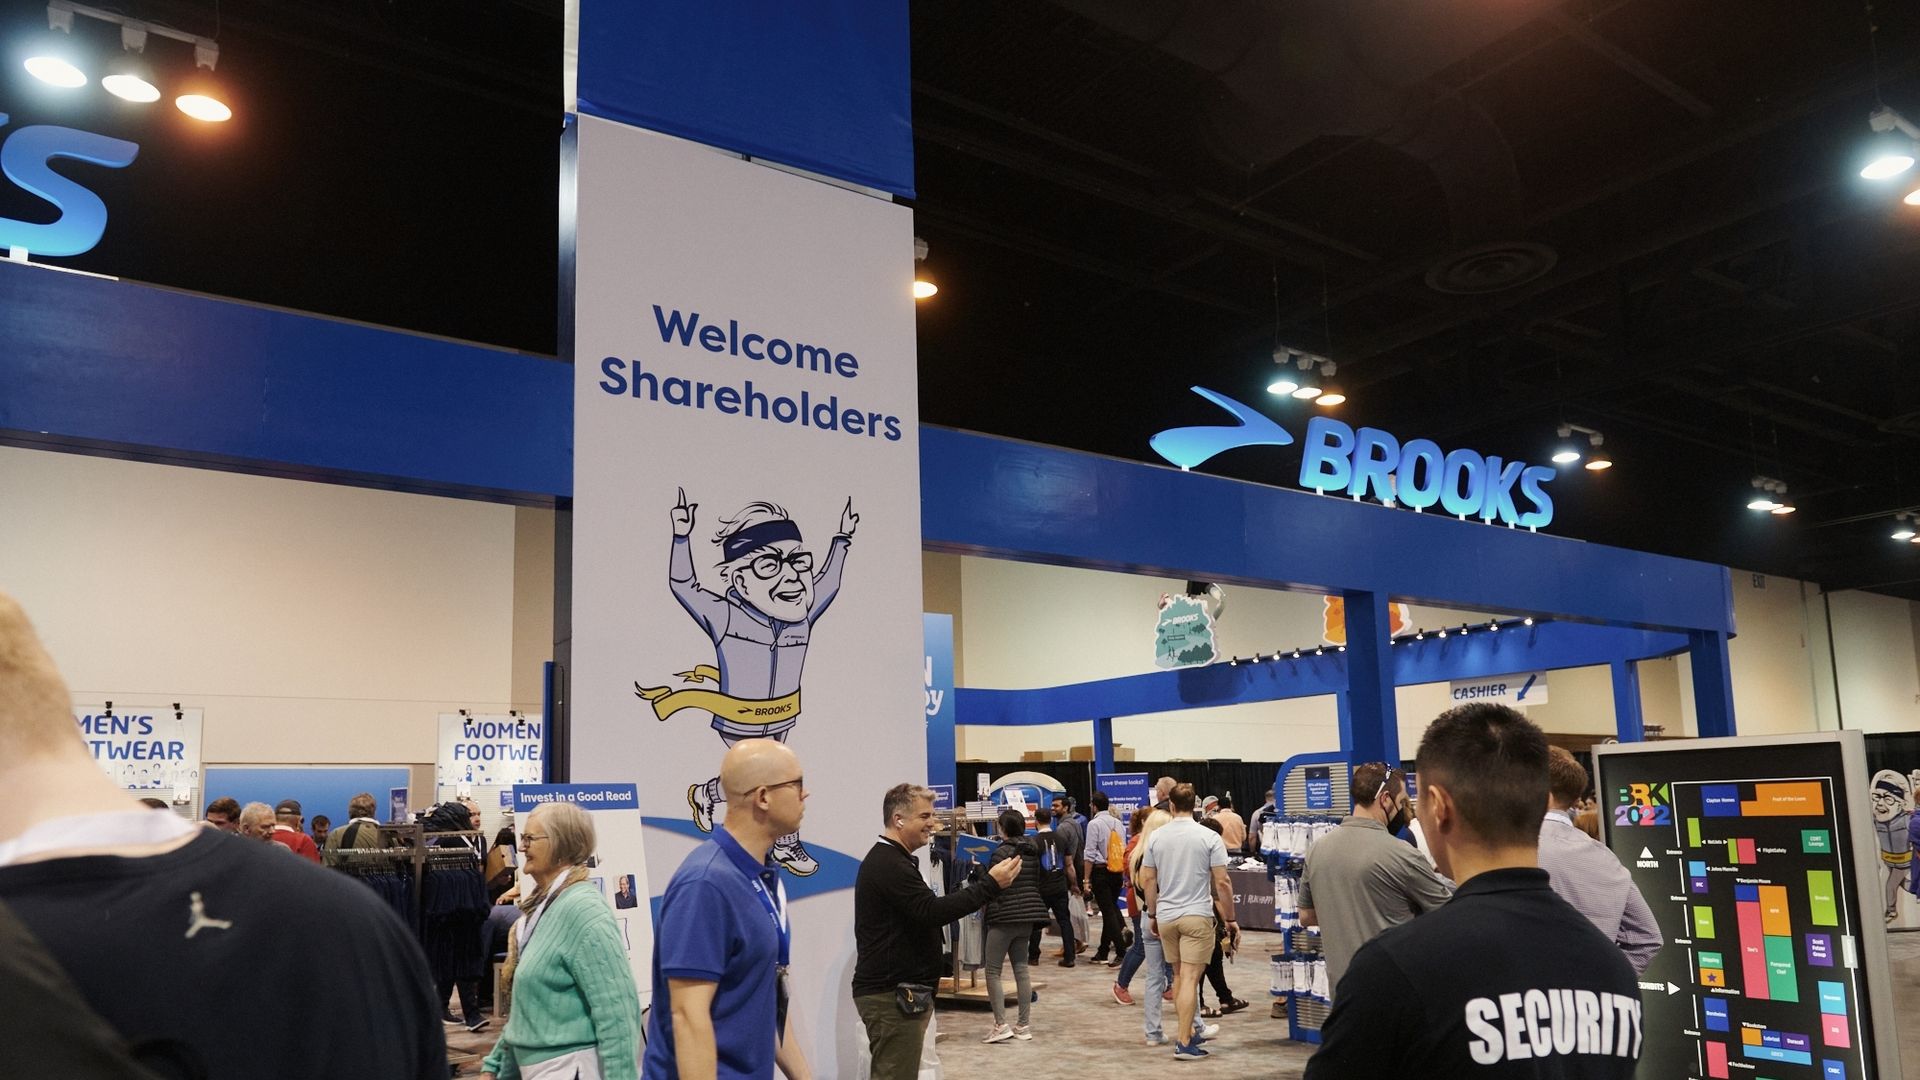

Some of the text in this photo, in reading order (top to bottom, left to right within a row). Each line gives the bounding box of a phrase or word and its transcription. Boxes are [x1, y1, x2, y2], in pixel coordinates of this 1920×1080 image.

[652, 304, 859, 378] Welcome
[599, 356, 902, 441] Shareholders
[1300, 416, 1557, 528] BROOKS
[1453, 683, 1507, 700] CASHIER
[755, 703, 792, 716] BROOKS
[84, 741, 184, 760] TWEAR
[454, 744, 543, 761] FOOTWE
[520, 792, 553, 803] Invest
[556, 792, 566, 802] in
[577, 791, 604, 801] Good
[606, 790, 632, 801] Read
[1620, 783, 1670, 806] BRK
[1615, 805, 1671, 826] 2022
[1636, 860, 1659, 868] NORTH
[1465, 989, 1643, 1065] SECURITY
